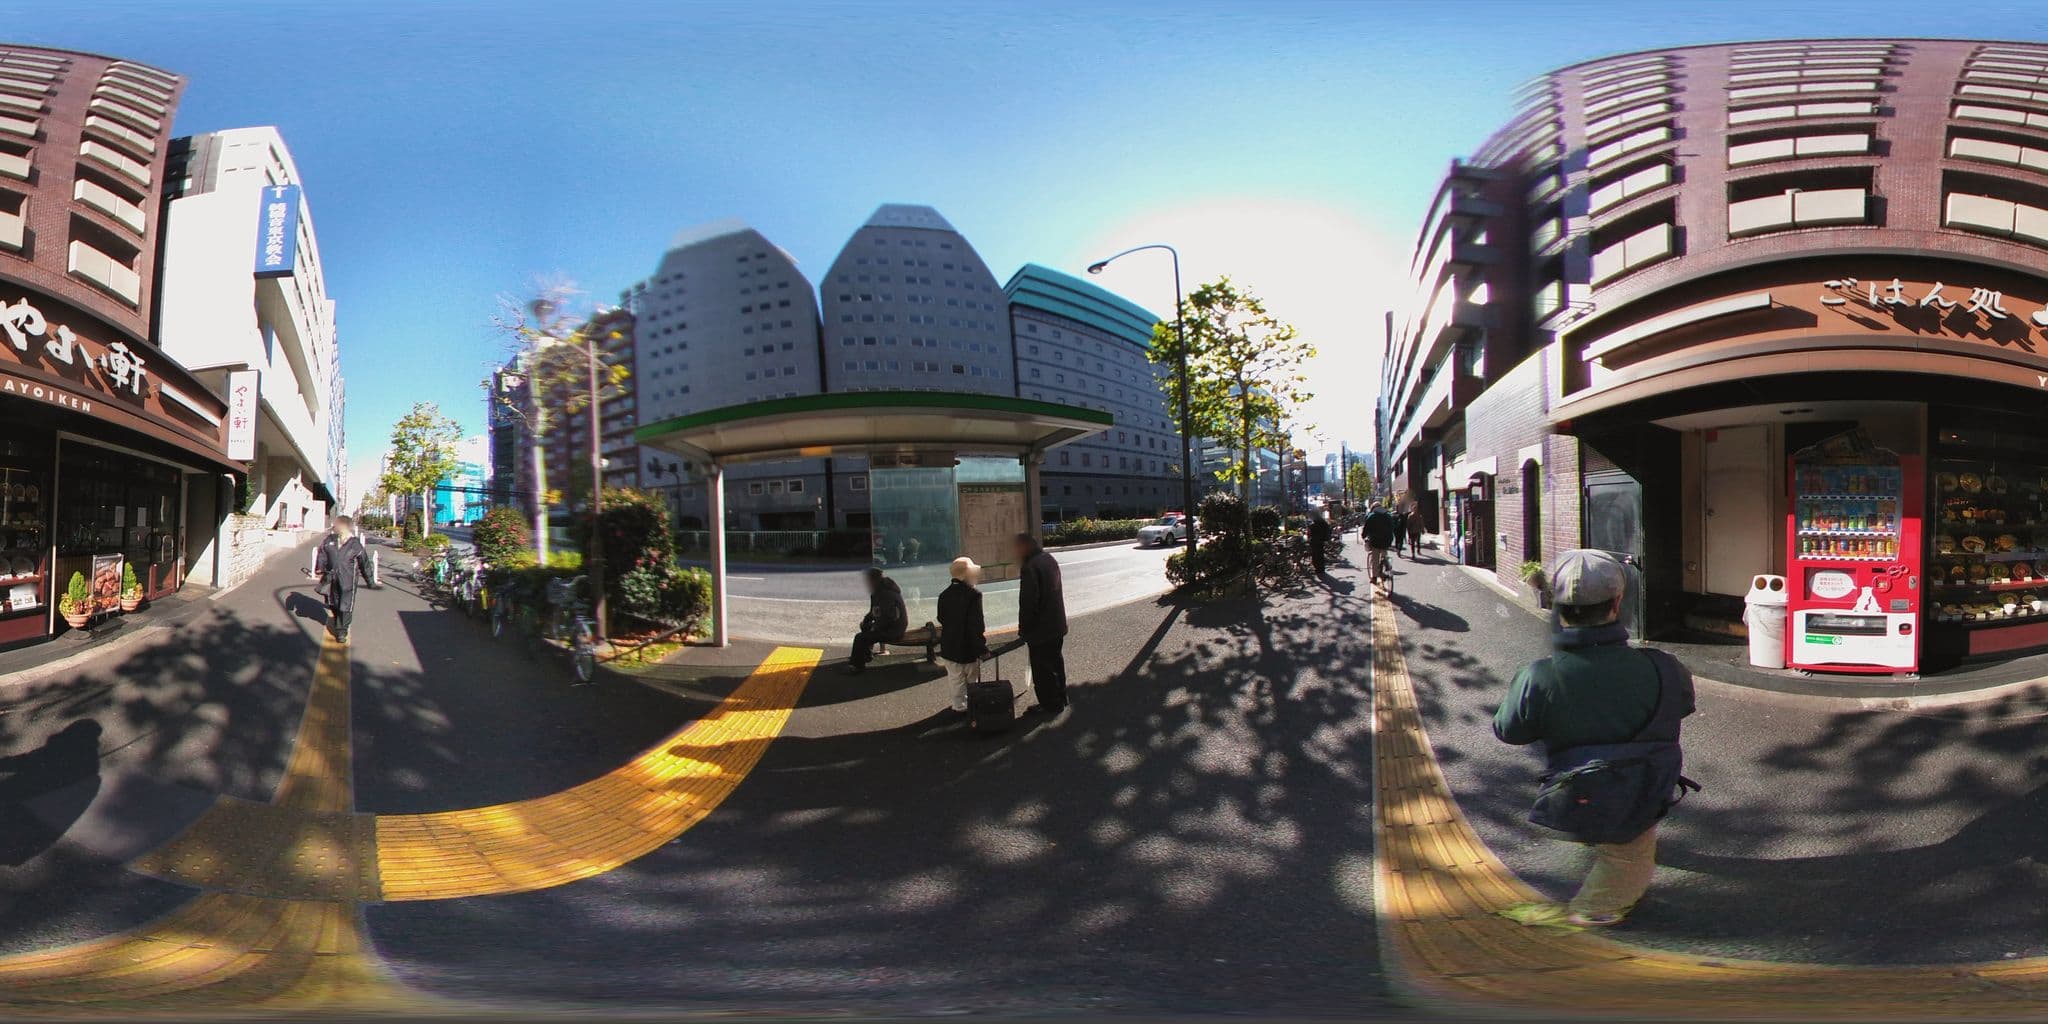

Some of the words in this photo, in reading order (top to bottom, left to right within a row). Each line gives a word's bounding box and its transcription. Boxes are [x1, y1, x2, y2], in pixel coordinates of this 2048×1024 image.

[1820, 278, 2008, 319] ごはん処
[0, 297, 147, 395] やよい軒
[4, 379, 91, 412] AYOIKEN
[235, 386, 248, 430] やよい軒
